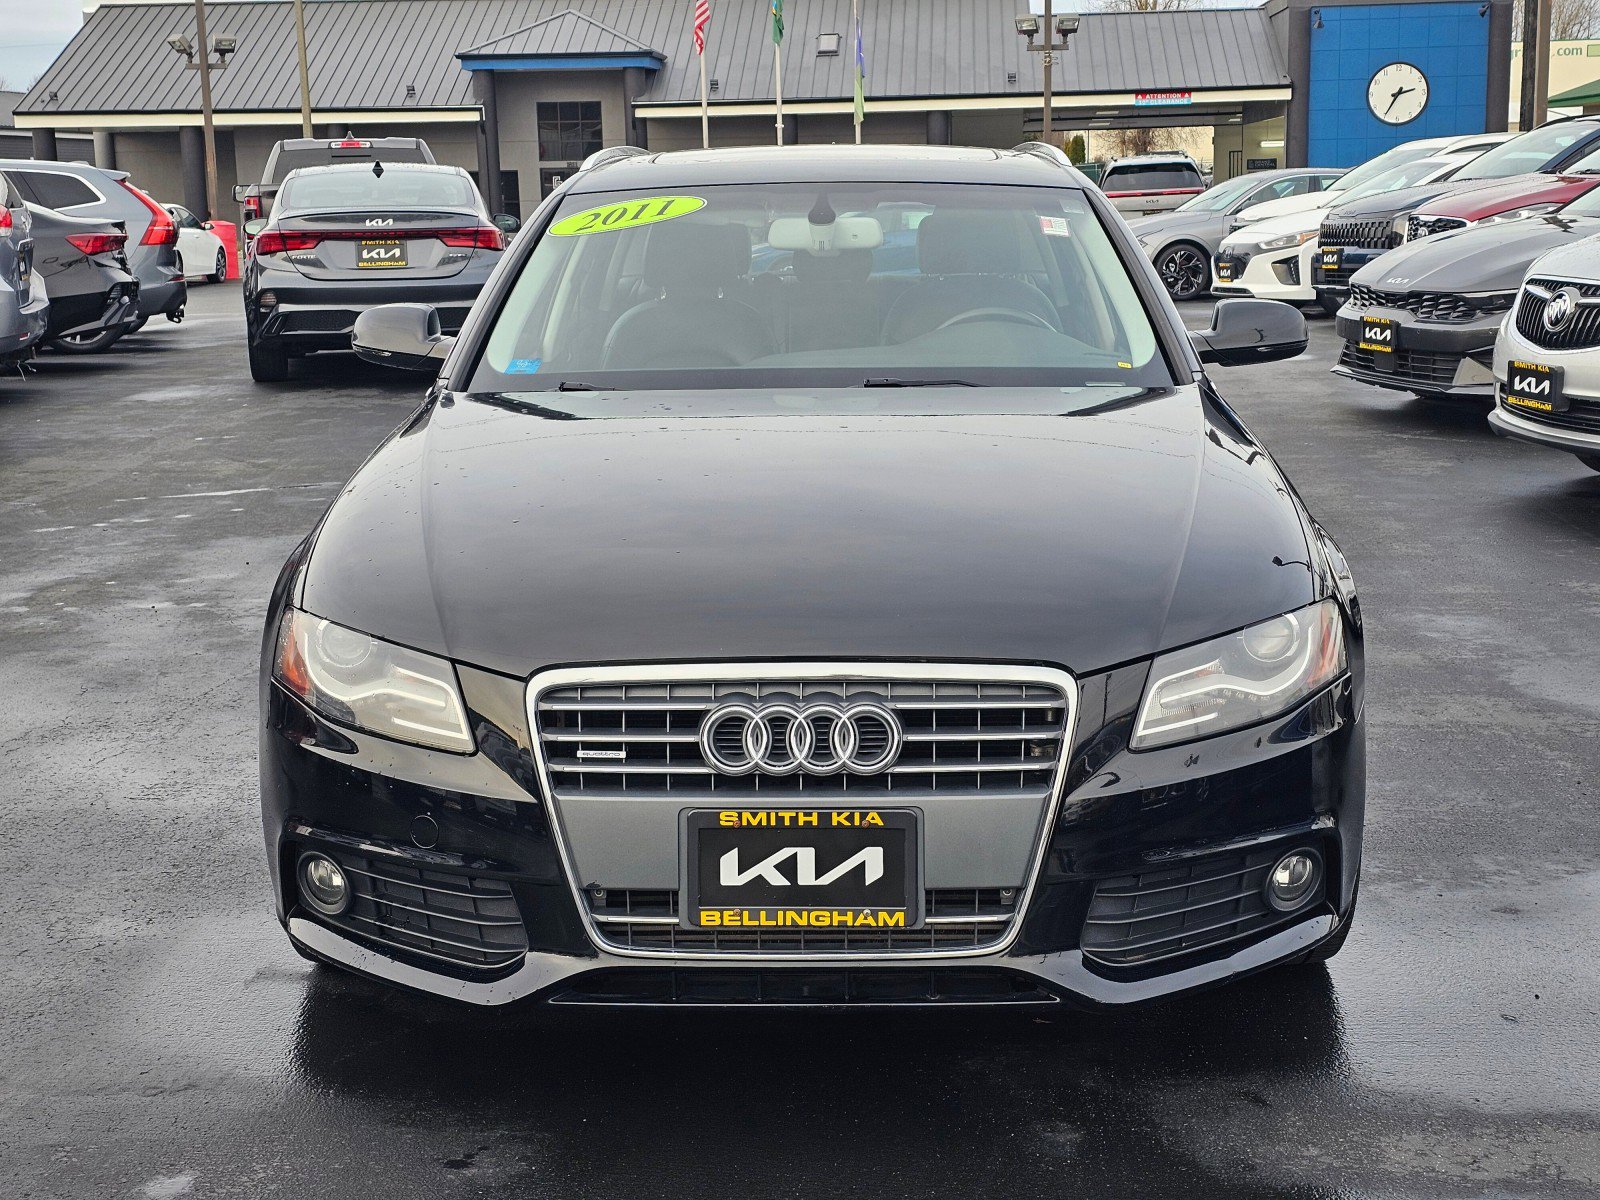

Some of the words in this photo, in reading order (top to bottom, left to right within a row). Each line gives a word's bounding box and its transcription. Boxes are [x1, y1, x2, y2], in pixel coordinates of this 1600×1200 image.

[365, 218, 394, 227] KIA
[573, 199, 675, 232] 2011
[362, 247, 401, 259] KIA
[1365, 326, 1392, 341] KIA
[1360, 342, 1392, 352] BELLINGHAM
[1514, 361, 1536, 370] SMITH
[1537, 364, 1550, 373] KIA
[1513, 375, 1551, 396] KIA
[1507, 396, 1552, 411] BELLINGHAM
[719, 811, 818, 826] SMITH
[831, 811, 884, 826] KIA
[719, 846, 884, 887] KIA
[700, 910, 905, 927] BELLINGHAM
